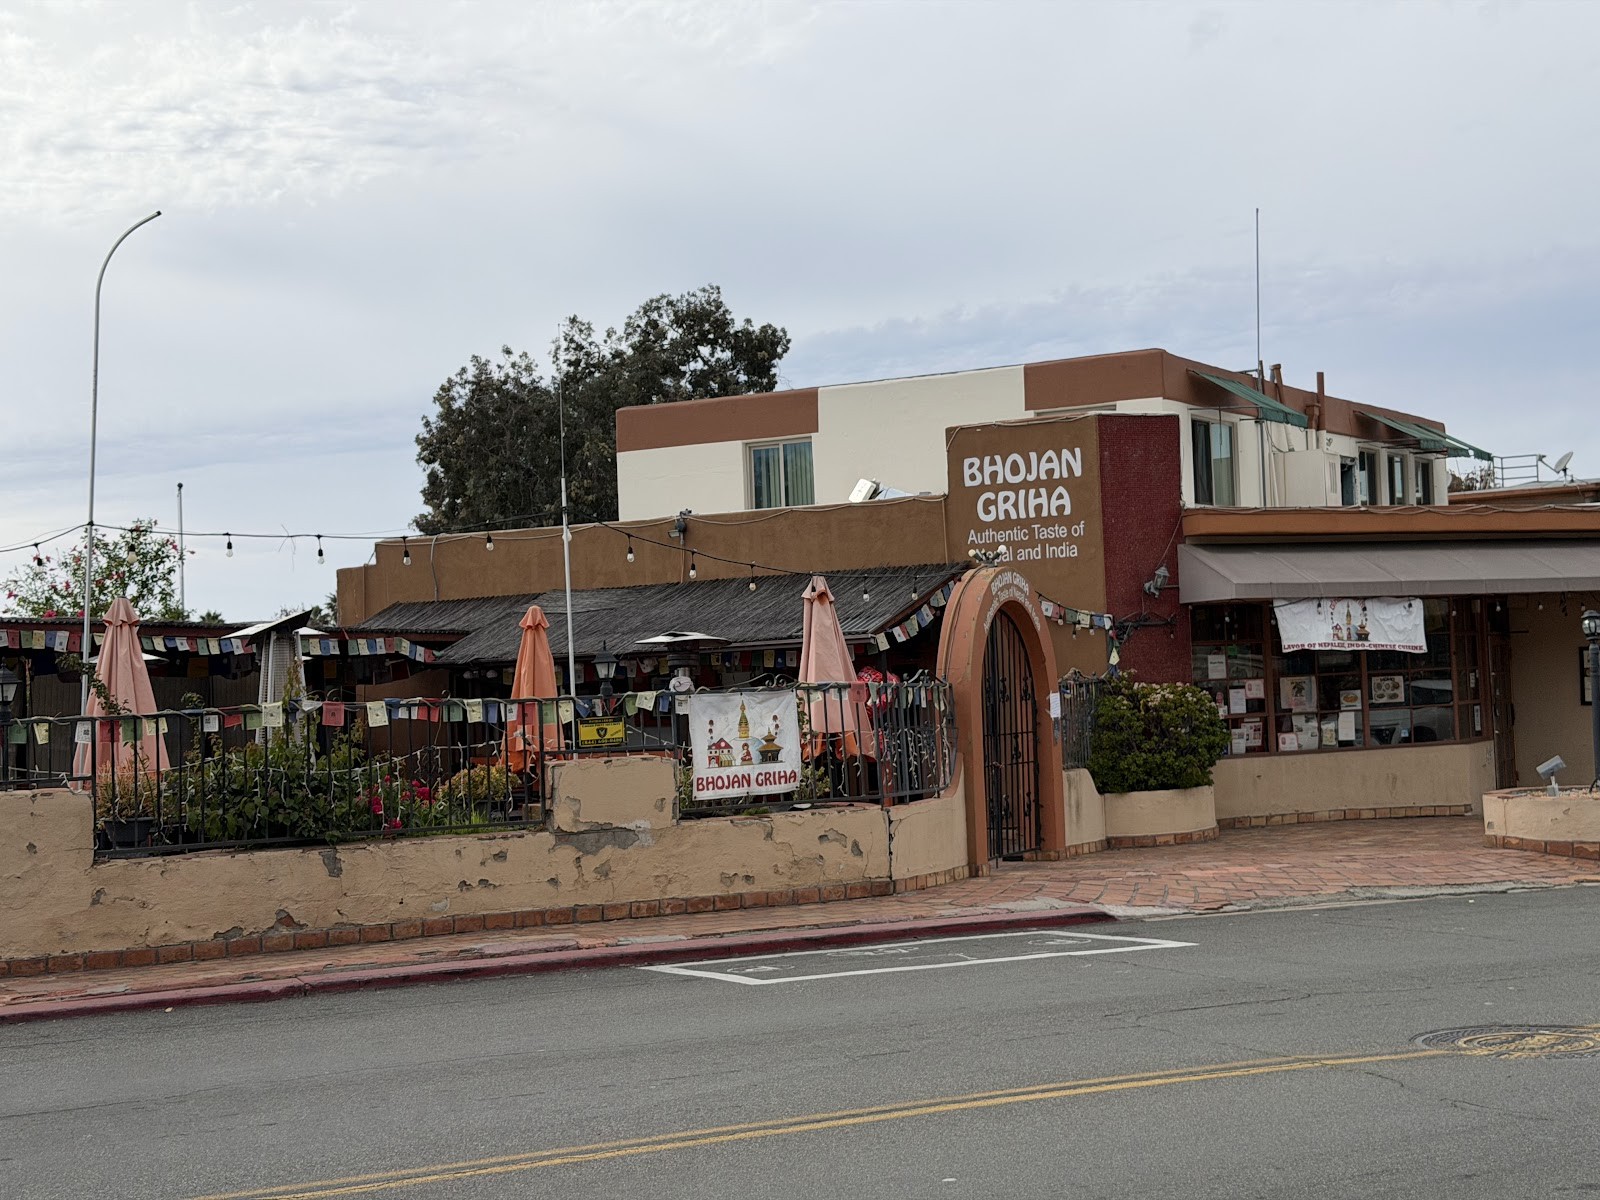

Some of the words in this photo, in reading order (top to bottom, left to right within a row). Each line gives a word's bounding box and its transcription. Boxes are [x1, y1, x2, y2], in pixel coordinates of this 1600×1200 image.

[963, 447, 1082, 487] BHOJAN
[976, 486, 1071, 522] GRIHA
[967, 526, 1029, 545] Authentic
[1031, 523, 1067, 540] Taste
[1071, 520, 1085, 537] of
[1017, 543, 1042, 561] and
[1046, 541, 1078, 559] India
[991, 572, 1012, 595] BHOJAN
[1012, 572, 1029, 595] GRIHA
[696, 773, 751, 792] BHOJAN
[755, 769, 797, 787] GRIHA
